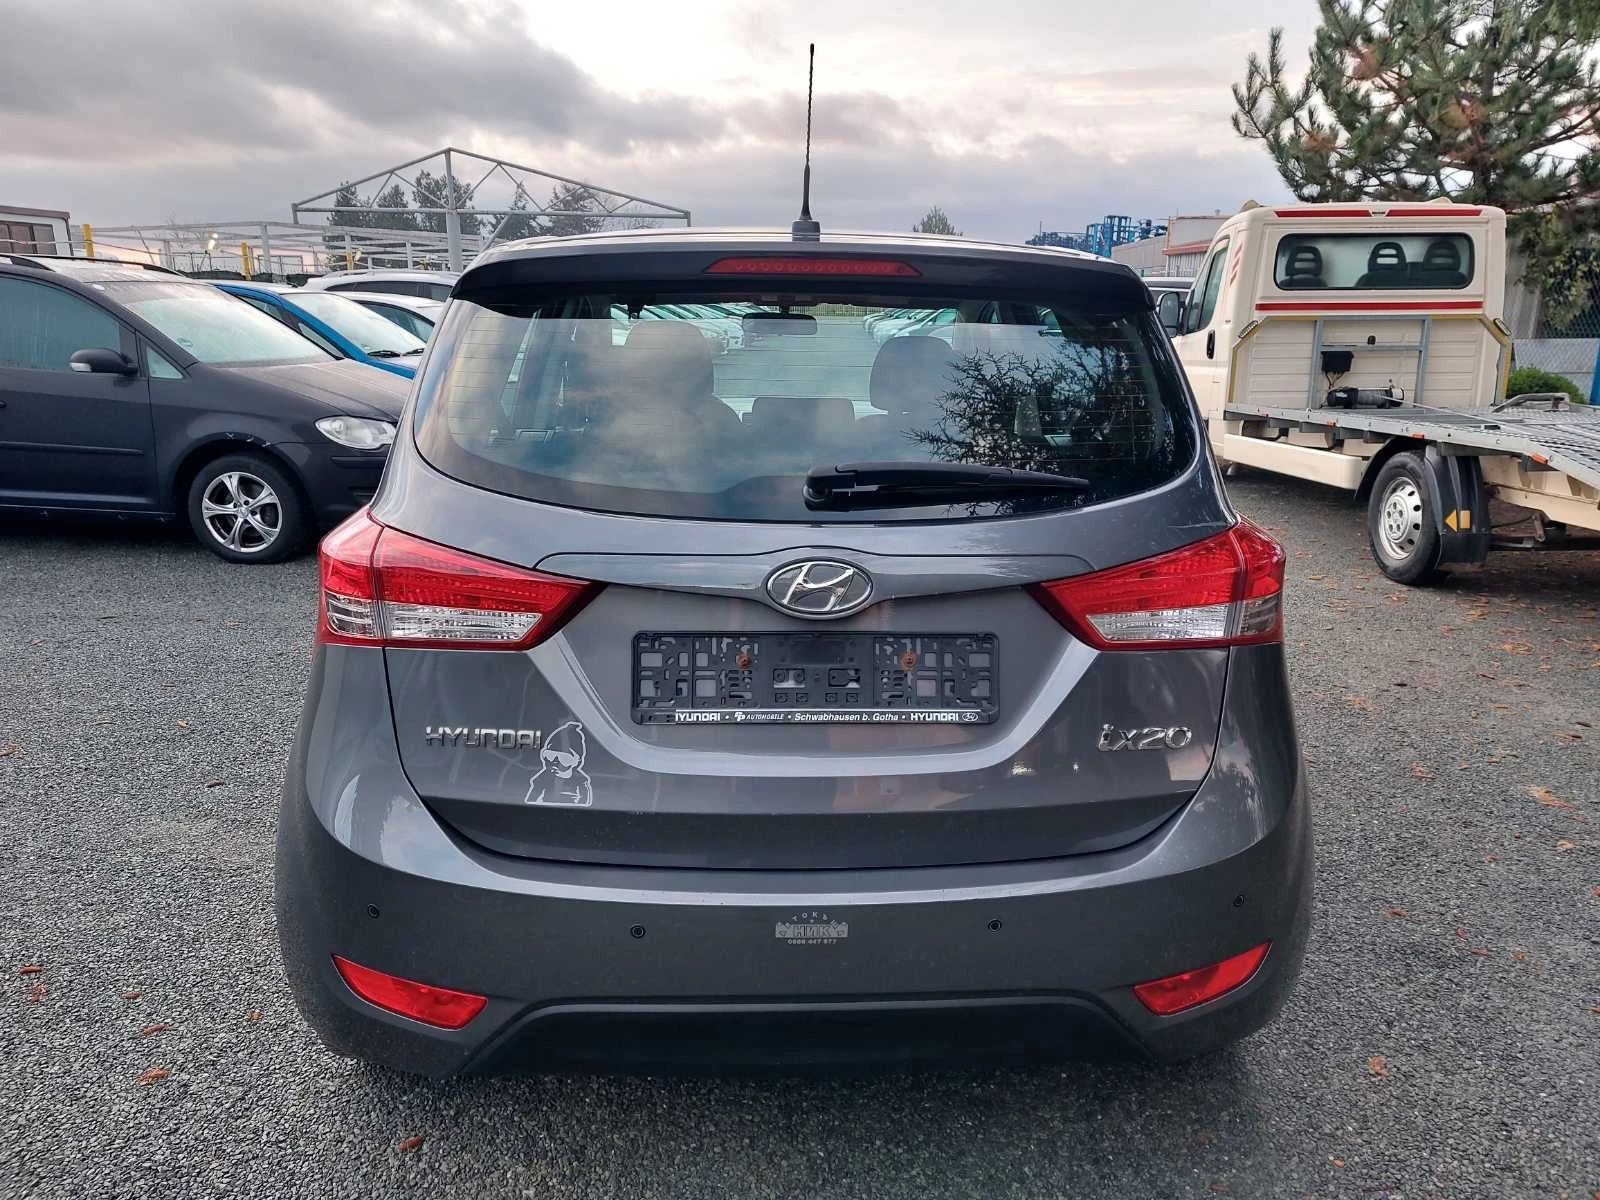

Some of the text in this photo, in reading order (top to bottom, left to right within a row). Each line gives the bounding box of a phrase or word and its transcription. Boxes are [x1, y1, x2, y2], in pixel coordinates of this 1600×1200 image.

[794, 712, 860, 721] Schwabhausen
[862, 712, 870, 721] b.
[872, 712, 899, 721] Gotha
[910, 712, 959, 721] HYUNDAI
[425, 726, 541, 749] HYUNDAI
[1098, 723, 1192, 751] ix20
